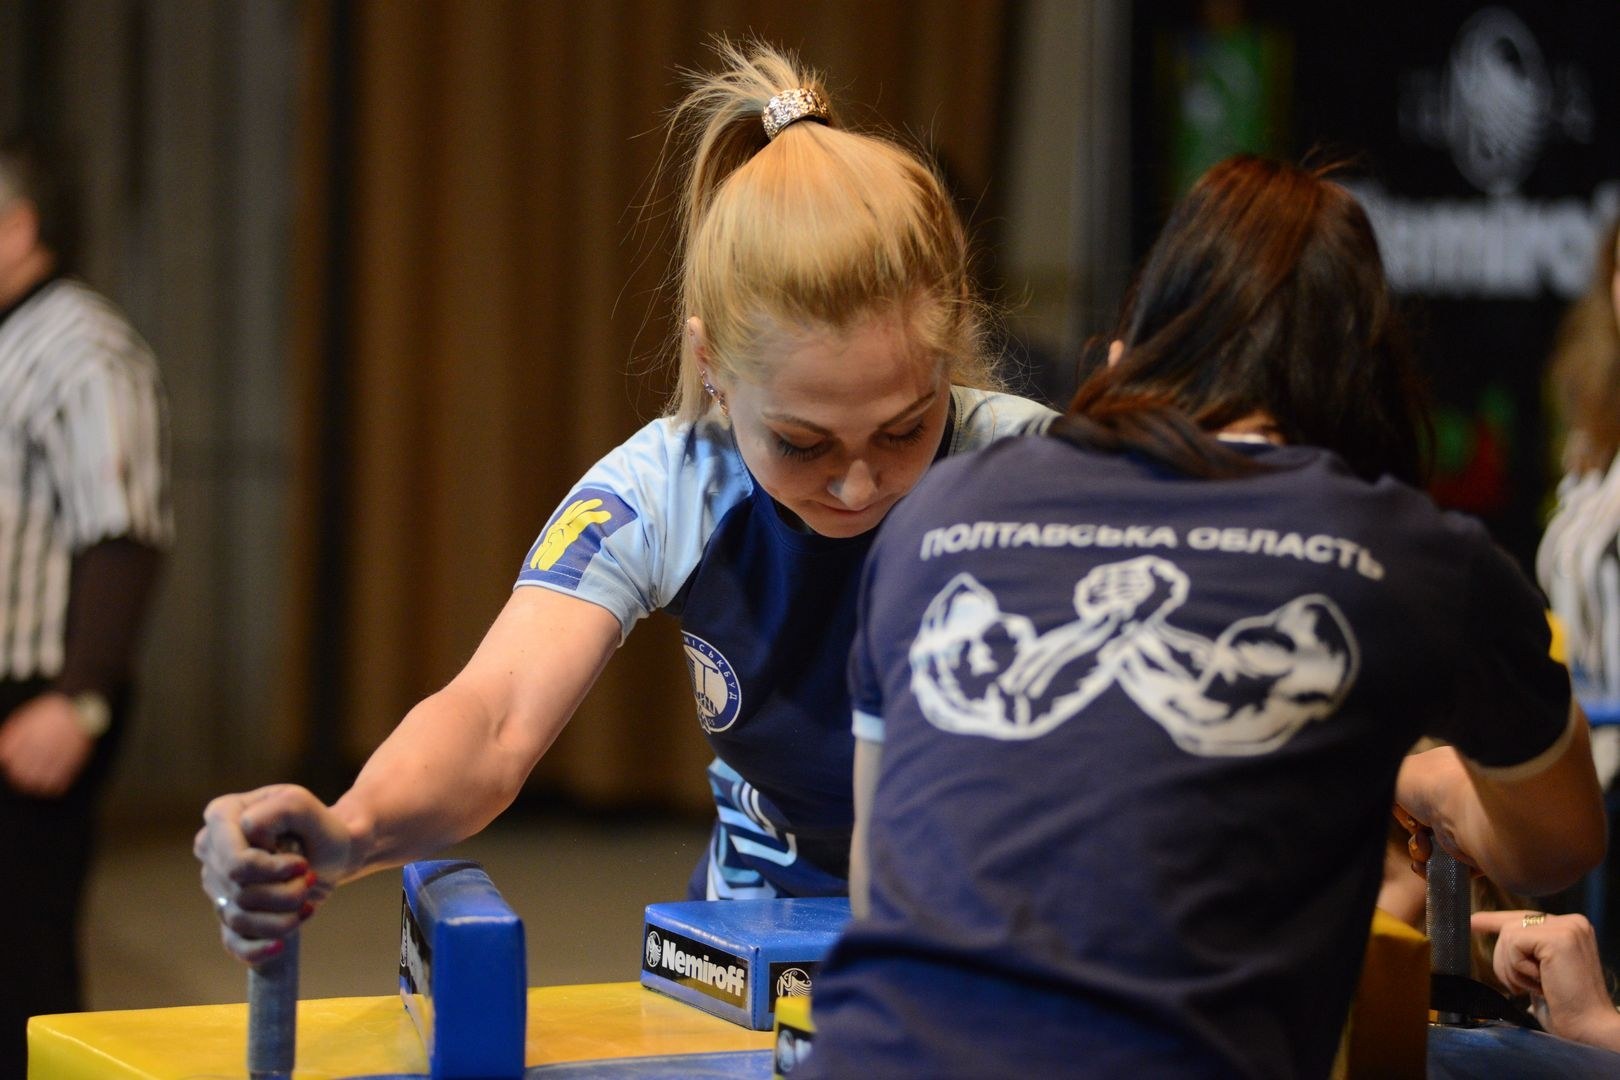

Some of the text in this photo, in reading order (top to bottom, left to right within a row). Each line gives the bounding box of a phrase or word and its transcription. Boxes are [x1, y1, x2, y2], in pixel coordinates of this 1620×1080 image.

[920, 521, 1385, 580] ПОЛТАВСЬКА ОБЛАСТЬ
[661, 939, 745, 997] Nemiroff
